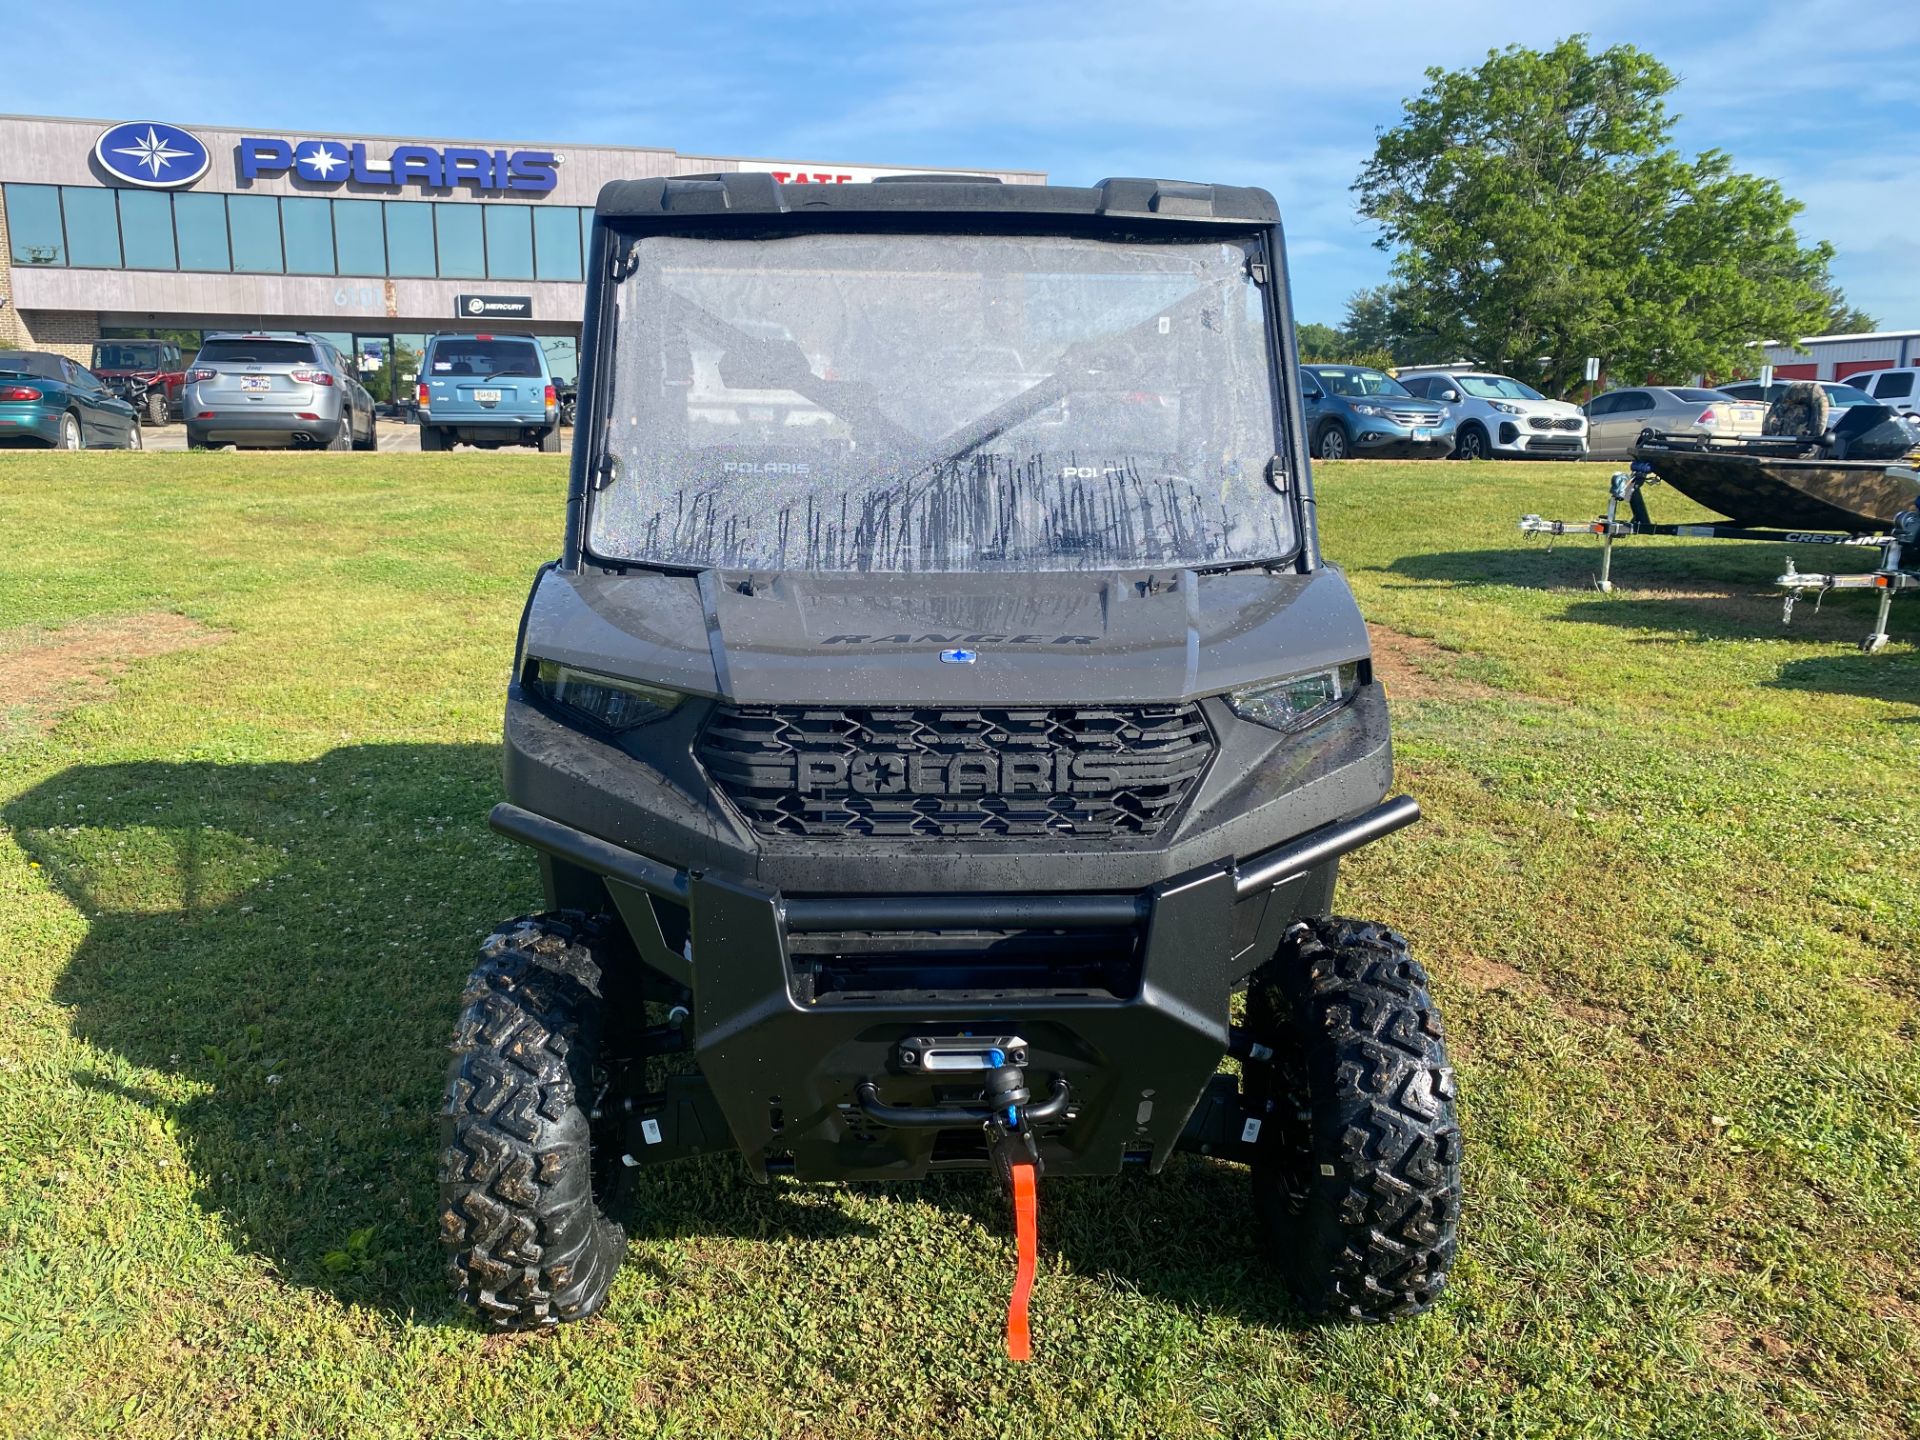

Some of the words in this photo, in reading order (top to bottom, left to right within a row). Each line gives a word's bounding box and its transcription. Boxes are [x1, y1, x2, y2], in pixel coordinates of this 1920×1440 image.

[240, 137, 558, 191] POLARIS
[485, 303, 524, 311] MERCURY
[723, 461, 811, 474] POLARIS
[820, 634, 1099, 645] RANGER
[798, 752, 1120, 794] POLARIS
